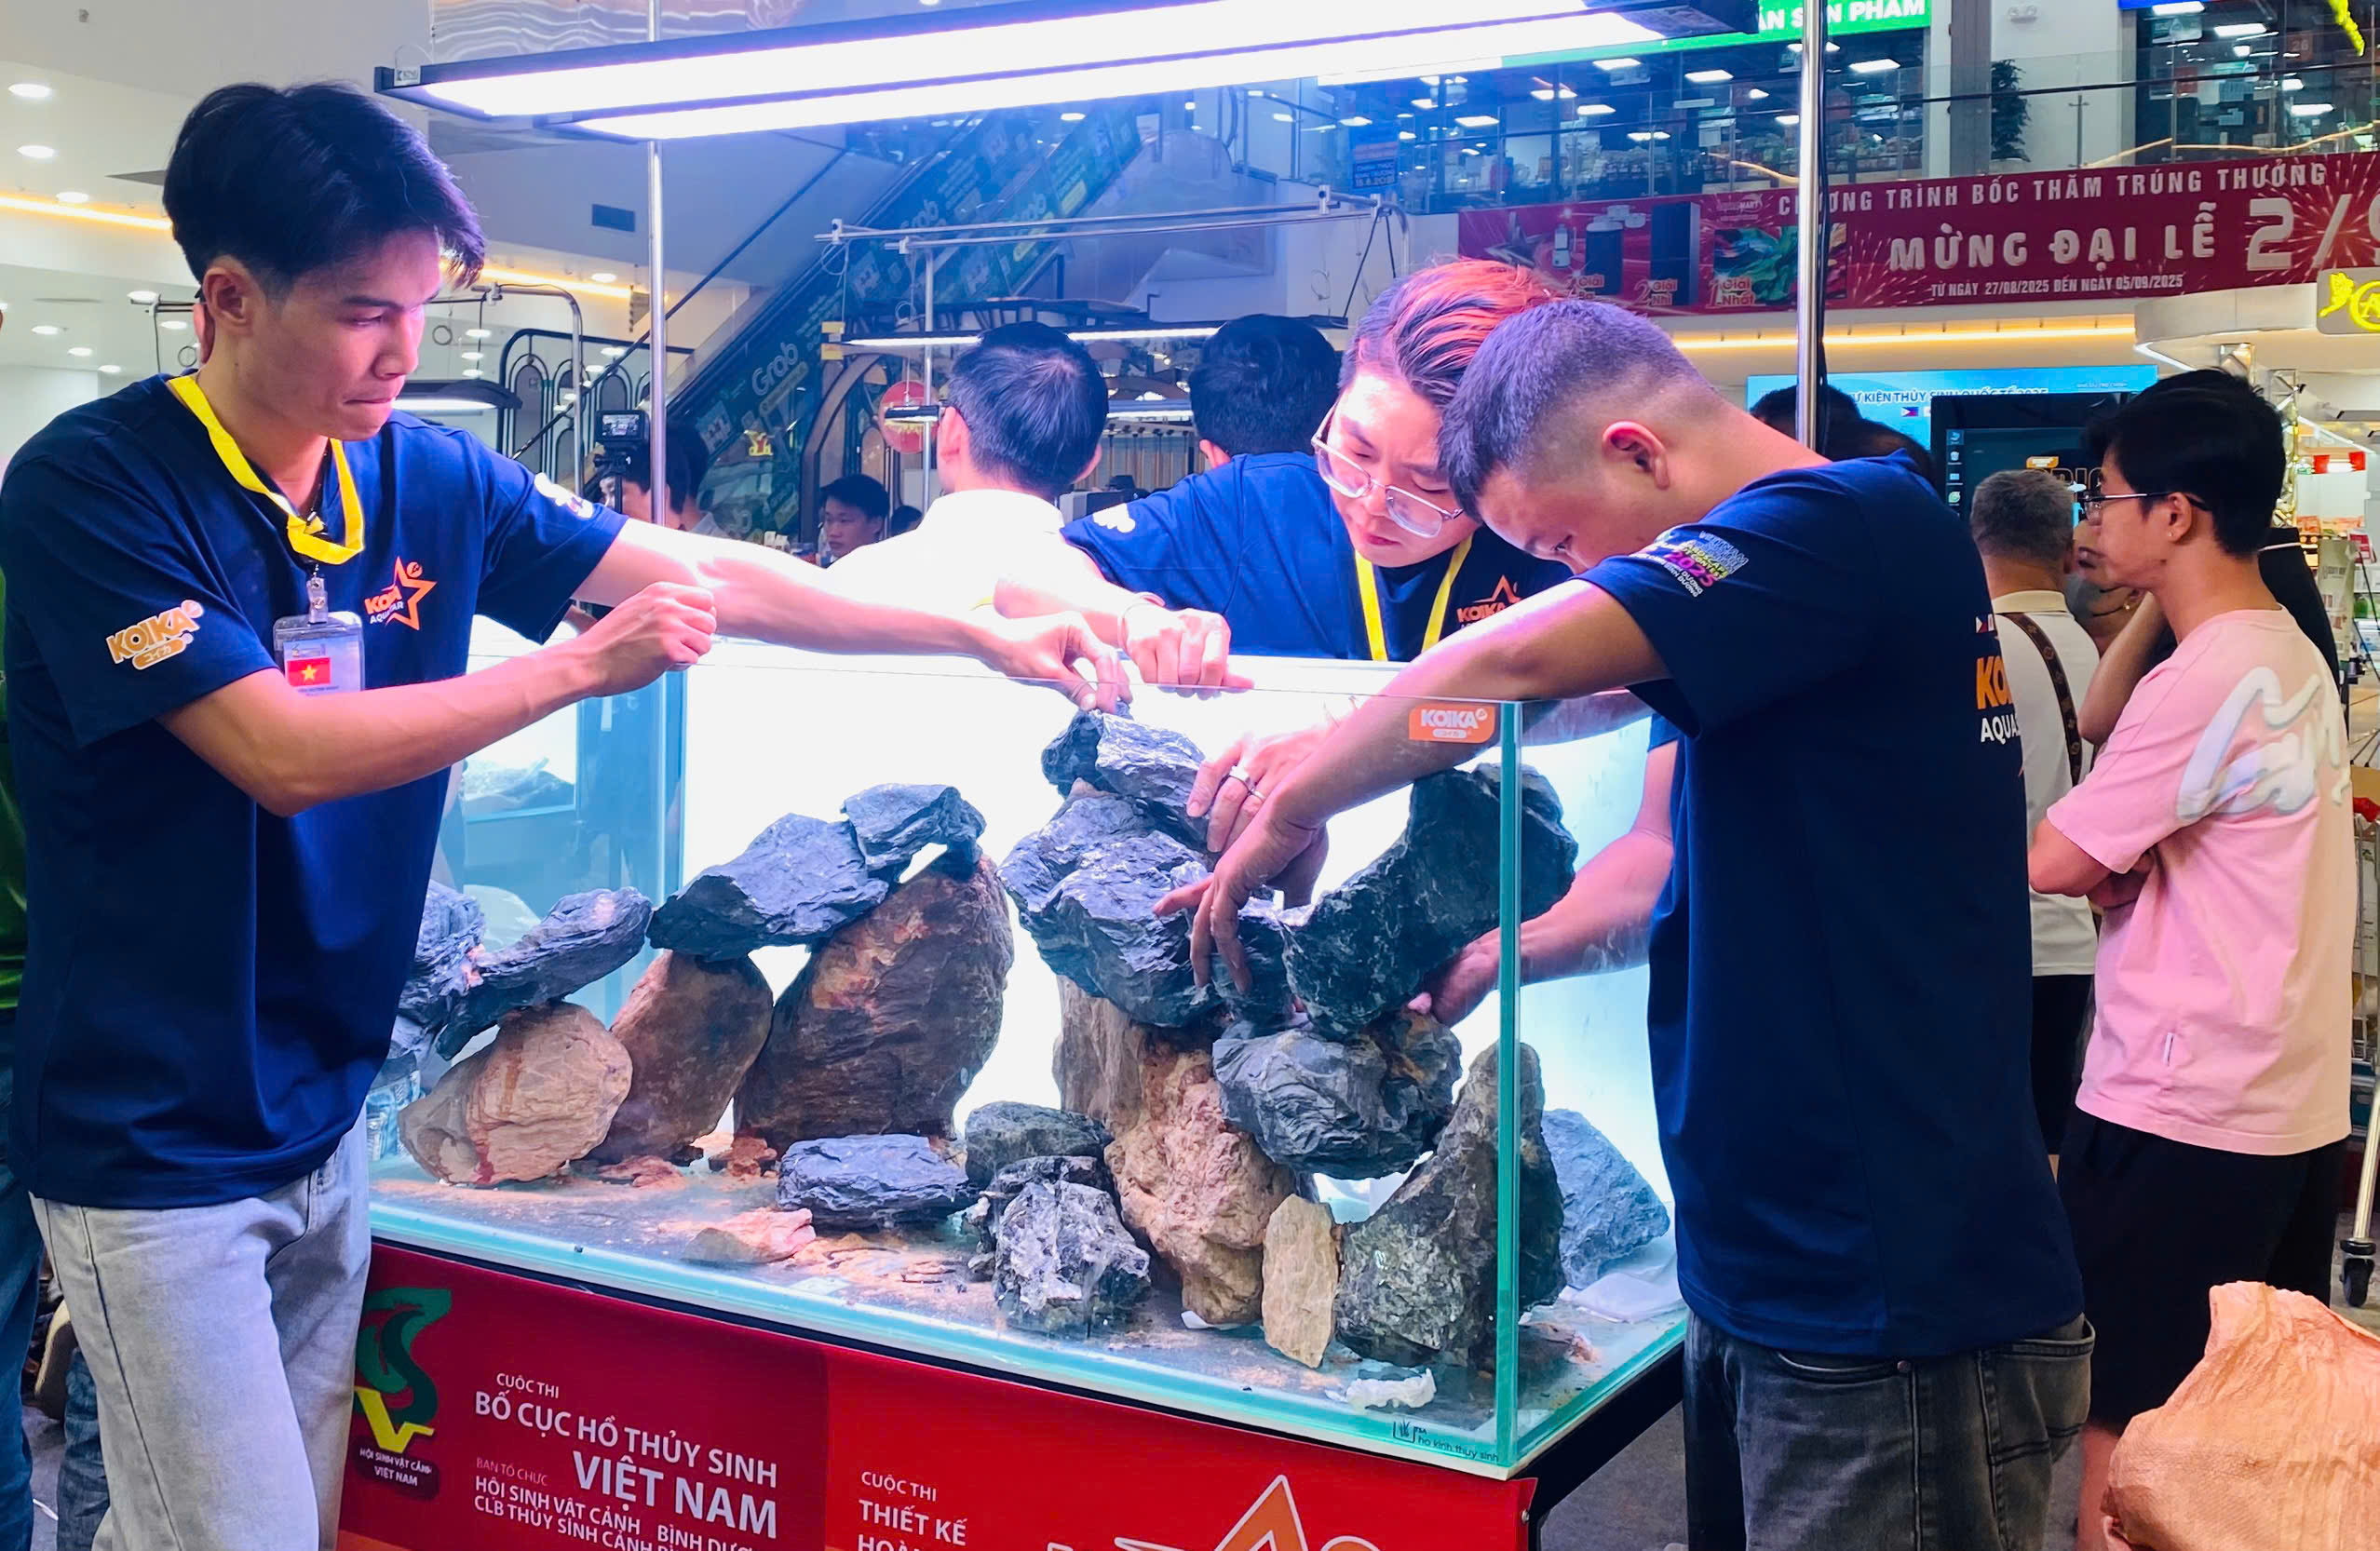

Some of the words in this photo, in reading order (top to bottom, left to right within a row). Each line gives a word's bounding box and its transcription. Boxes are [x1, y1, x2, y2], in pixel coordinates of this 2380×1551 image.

[1791, 3, 1843, 28] SN
[1778, 190, 1873, 216] CƠNG
[1886, 183, 1958, 209] TRÌNH
[1972, 175, 2020, 205] BỐC
[2034, 174, 2103, 201] THĂM
[2116, 169, 2201, 196] TRÚNG
[2217, 158, 2327, 191] THƯỞNG
[1889, 223, 2028, 272] MỪNG
[2049, 226, 2137, 272] ĐẠI
[2165, 201, 2217, 260] LỄ
[2247, 193, 2380, 272] 2/
[1984, 279, 2049, 296] 27/08/2025
[2116, 274, 2184, 290] 05/09/2025
[751, 342, 799, 396] Grab
[1664, 550, 1714, 587] 2025
[106, 606, 200, 664] KOIKA
[1420, 708, 1479, 729] KOIKA
[496, 1372, 534, 1394] CUỘC
[536, 1382, 559, 1399] THI
[476, 1390, 511, 1421] BỐ
[518, 1402, 572, 1438] CỤC
[577, 1415, 618, 1448] HỒ
[624, 1429, 701, 1468] THỦY
[708, 1448, 778, 1488] SINH
[396, 1472, 418, 1487] NAM
[477, 1456, 498, 1473] BAN
[861, 1471, 907, 1495] CUỘC
[910, 1482, 938, 1503] THI
[476, 1476, 506, 1502] HỘI
[509, 1485, 550, 1510] SINH
[589, 1505, 641, 1536] CẢNH
[657, 1524, 702, 1551] BÌNH
[573, 1450, 664, 1512] VIỆT
[675, 1477, 778, 1539] NAM
[474, 1495, 505, 1517] CLB
[507, 1502, 553, 1530] THỦY
[558, 1518, 598, 1543] SINH
[602, 1530, 653, 1551] CẢNH
[859, 1499, 930, 1536] THIẾT
[935, 1517, 968, 1546] KẾ
